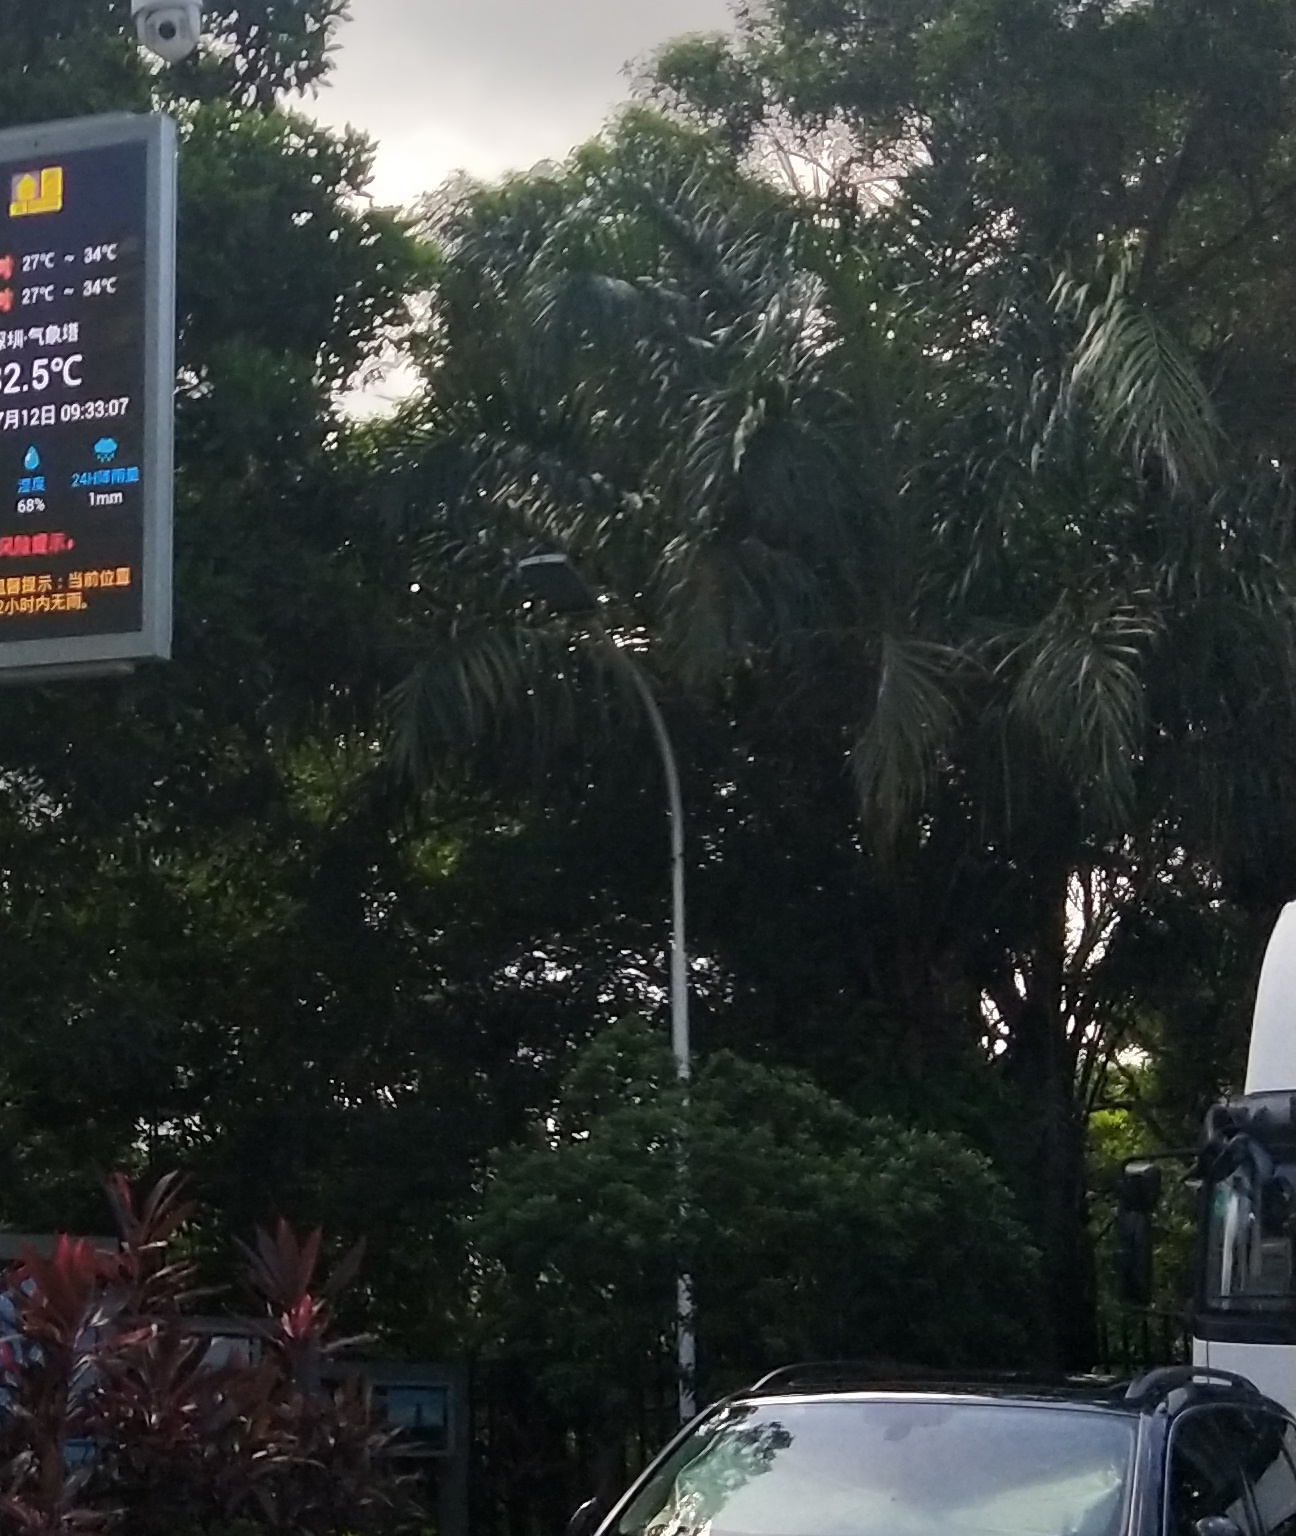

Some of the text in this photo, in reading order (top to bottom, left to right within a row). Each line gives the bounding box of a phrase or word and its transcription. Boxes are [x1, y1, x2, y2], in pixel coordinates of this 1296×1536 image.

[60, 397, 130, 422] 09:33:07
[17, 476, 46, 494] 湿度
[17, 498, 46, 514] 68%
[88, 491, 123, 507] 1mm
